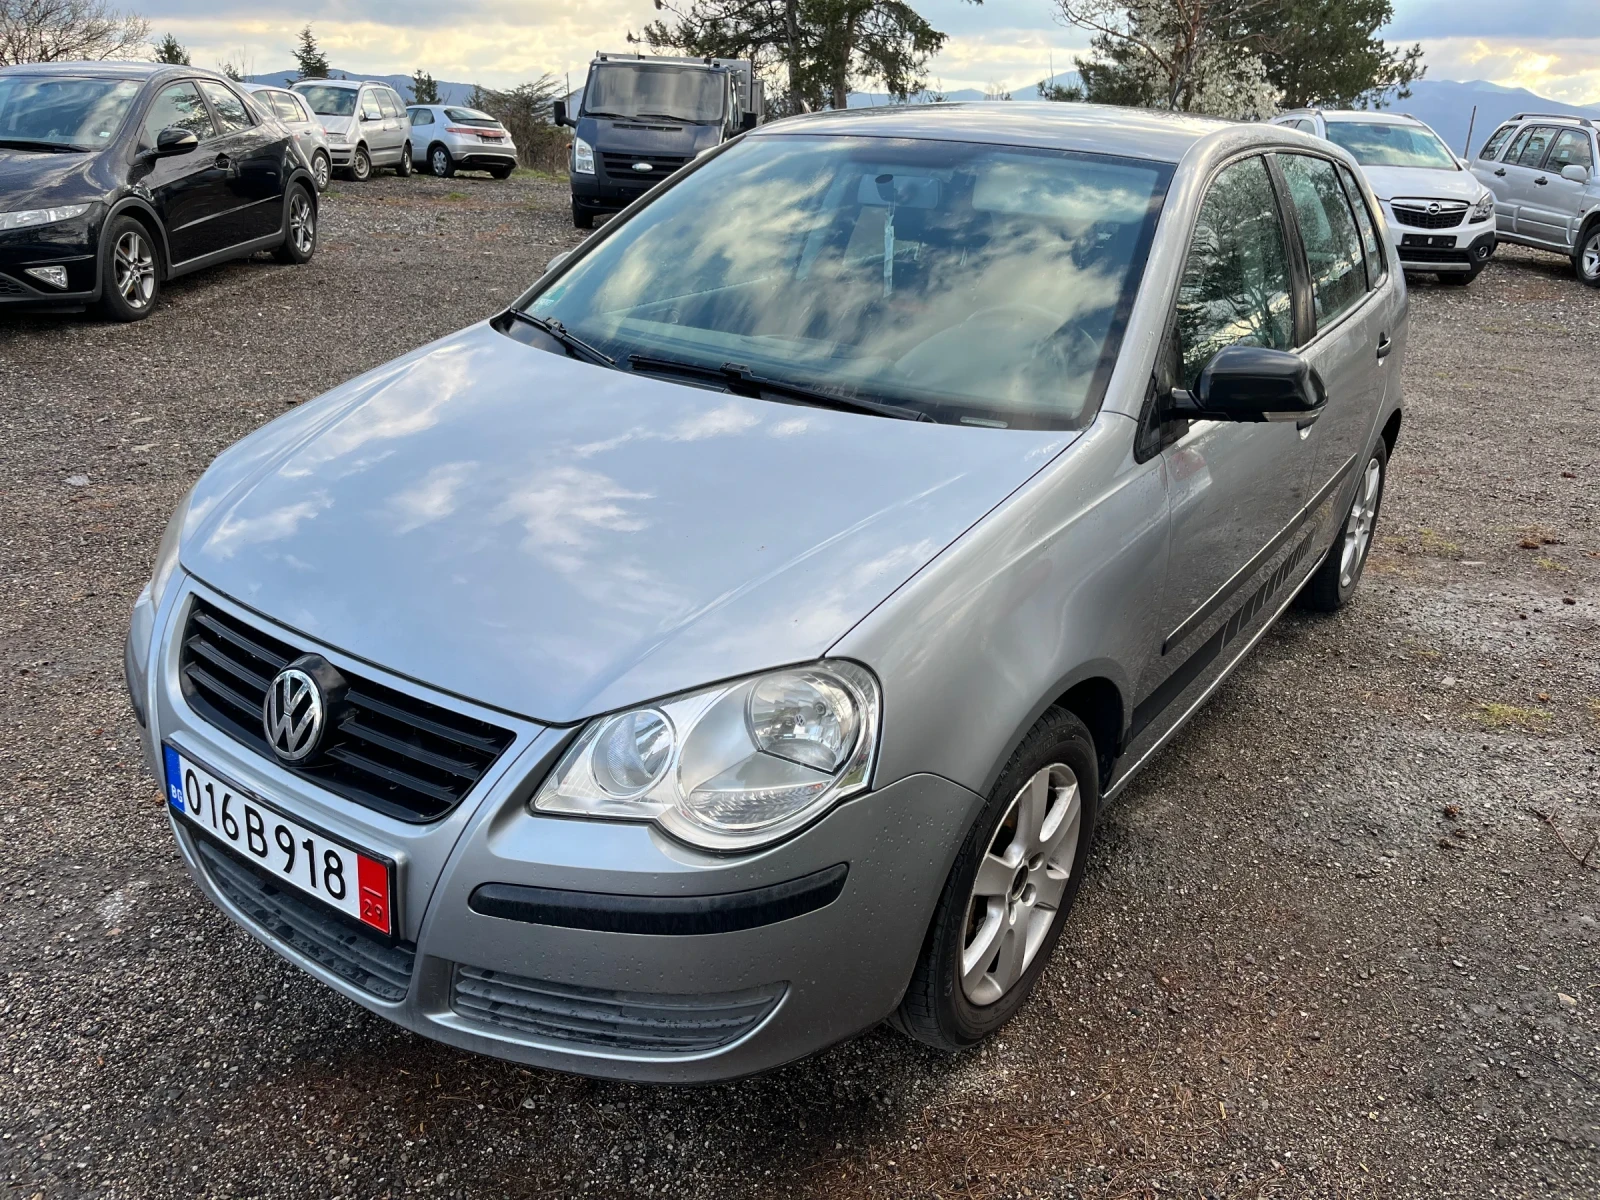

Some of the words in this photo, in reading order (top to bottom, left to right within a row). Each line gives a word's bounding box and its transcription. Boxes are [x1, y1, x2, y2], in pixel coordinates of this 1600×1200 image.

[265, 671, 321, 759] VW
[170, 783, 183, 803] BG
[185, 768, 346, 901] 016B918
[364, 898, 385, 921] 29
